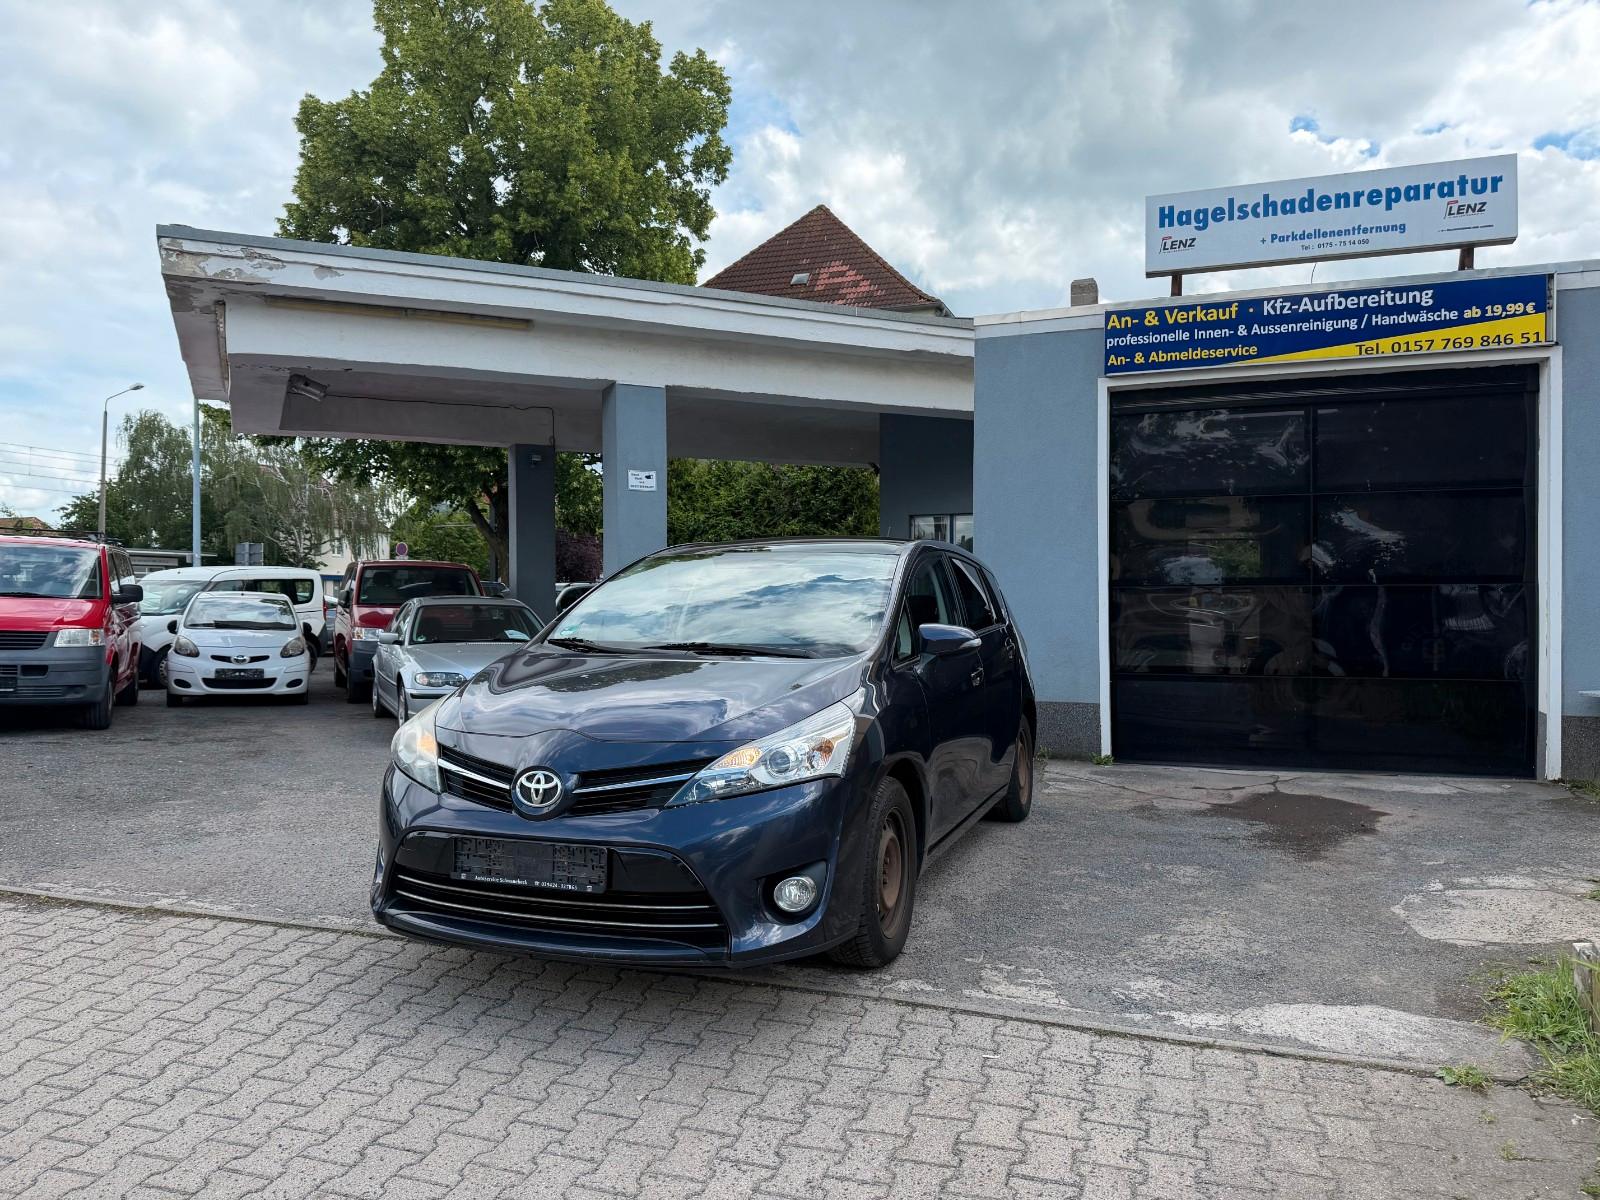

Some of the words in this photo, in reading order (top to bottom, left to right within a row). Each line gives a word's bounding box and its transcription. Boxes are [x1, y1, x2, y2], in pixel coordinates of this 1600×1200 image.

[1158, 174, 1504, 231] Hagelschadenreparatur
[1448, 201, 1487, 216] LENZ
[1162, 237, 1197, 251] LENZ
[1270, 223, 1407, 243] Parkdellenentfernung
[1317, 241, 1333, 249] 0175
[1107, 314, 1139, 329] An-
[1144, 310, 1159, 326] &
[1165, 302, 1239, 324] Verkauf
[1263, 288, 1434, 316] Kfz-Aufbereitung
[1106, 331, 1190, 349] professionelle
[1194, 327, 1235, 340] Innen-
[1237, 324, 1248, 336] &
[1251, 317, 1358, 335] Aussenreinigung
[1371, 308, 1459, 326] Handwäsche
[1463, 306, 1481, 318] ab
[1355, 343, 1385, 356] Tel.
[1391, 338, 1435, 354] 0157
[1441, 336, 1474, 350] 769
[1480, 332, 1514, 347] 846
[1520, 331, 1540, 344] 51
[1107, 354, 1131, 366] An-
[1134, 351, 1145, 364] &
[1149, 344, 1258, 364] Abmeldeservice
